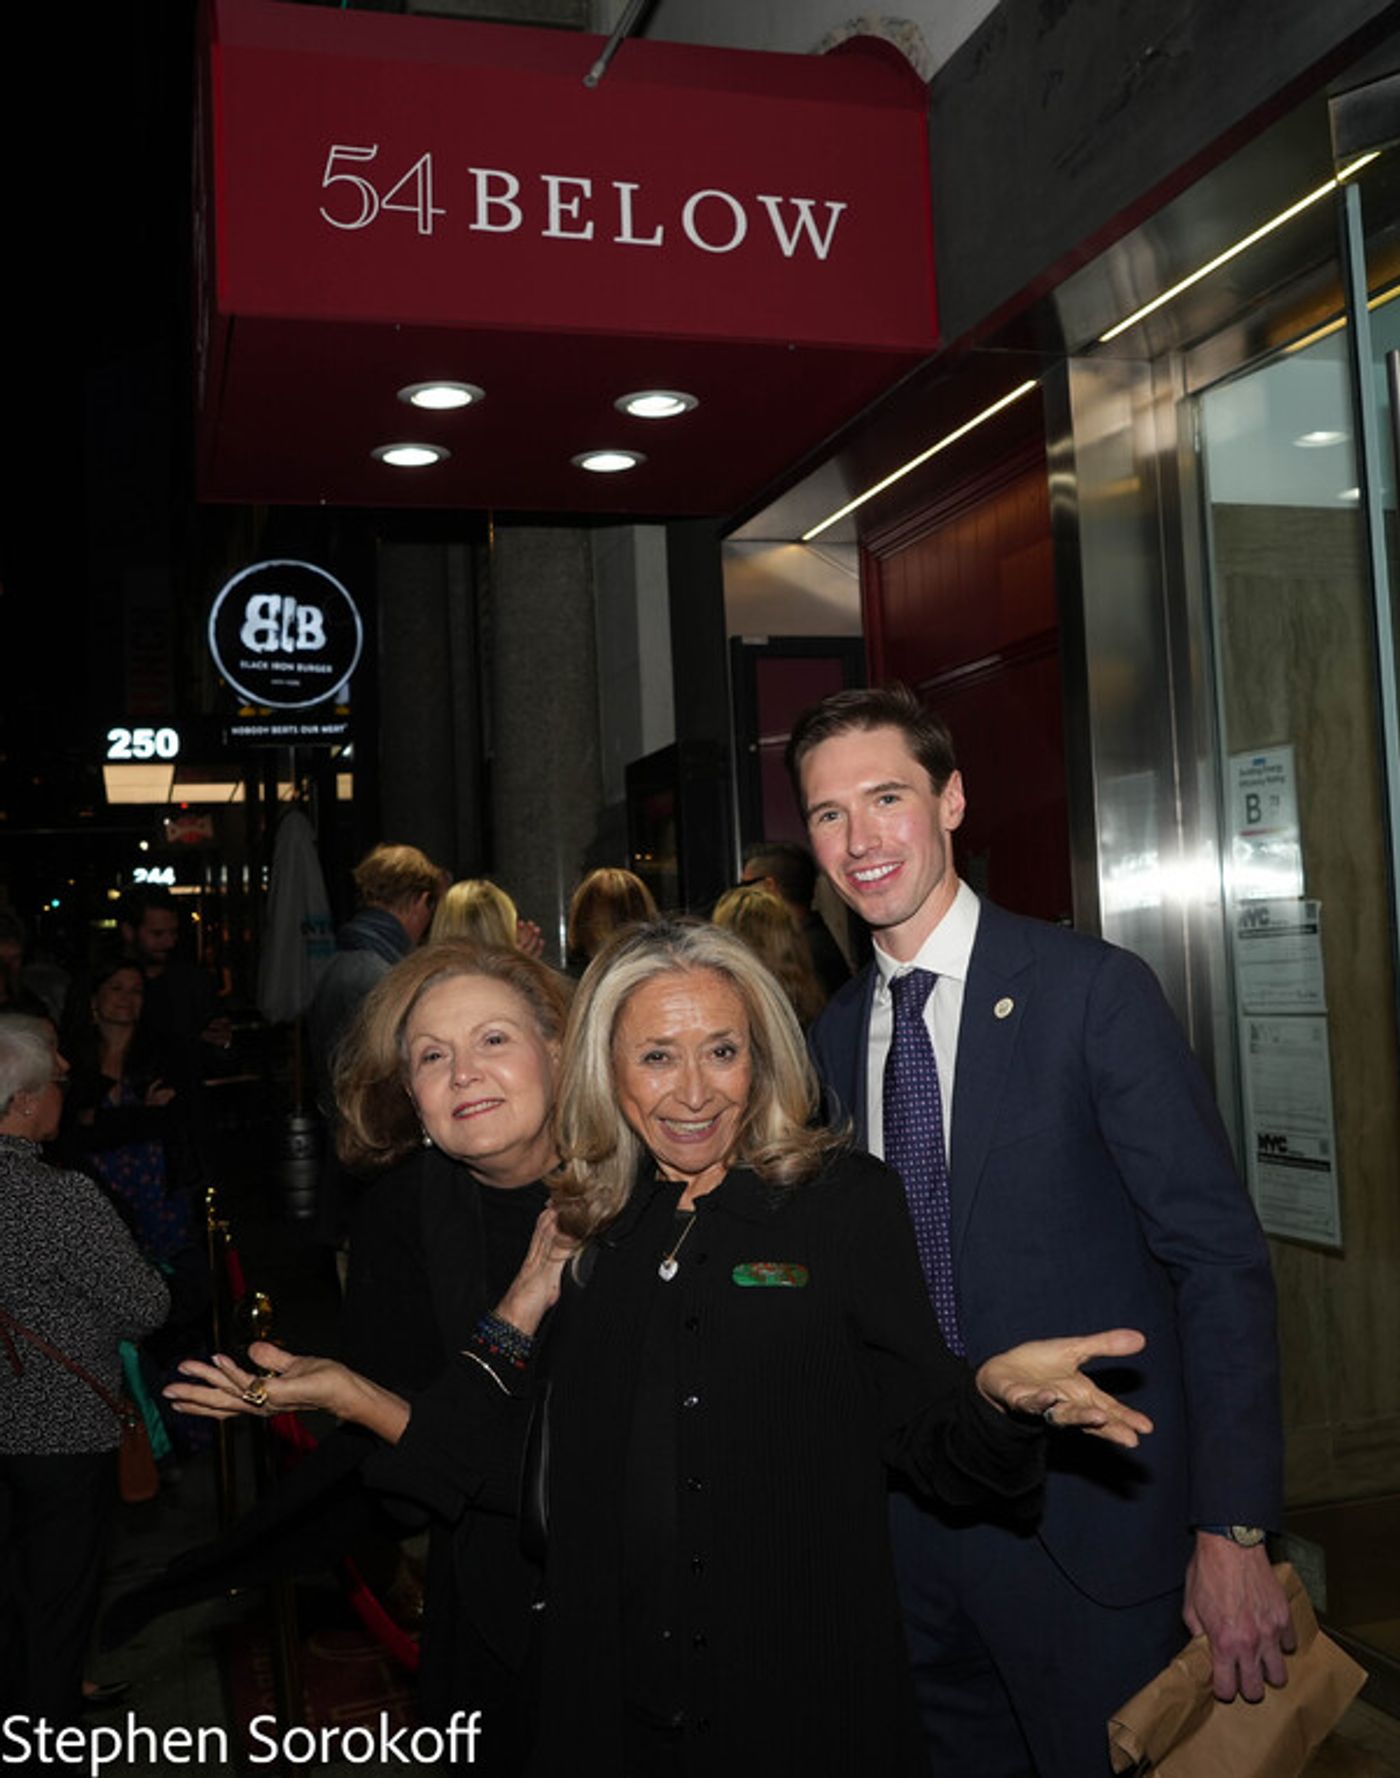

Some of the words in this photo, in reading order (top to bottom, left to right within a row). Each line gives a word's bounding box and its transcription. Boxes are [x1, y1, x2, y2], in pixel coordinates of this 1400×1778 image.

[319, 143, 446, 236] 54
[467, 166, 848, 261] BELOW
[239, 659, 268, 671] BLACK
[270, 661, 295, 672] IRON
[296, 662, 334, 674] BURGER
[106, 727, 180, 760] 250
[1245, 792, 1262, 825] B
[132, 865, 177, 886] 244
[1257, 1132, 1288, 1153] NYC
